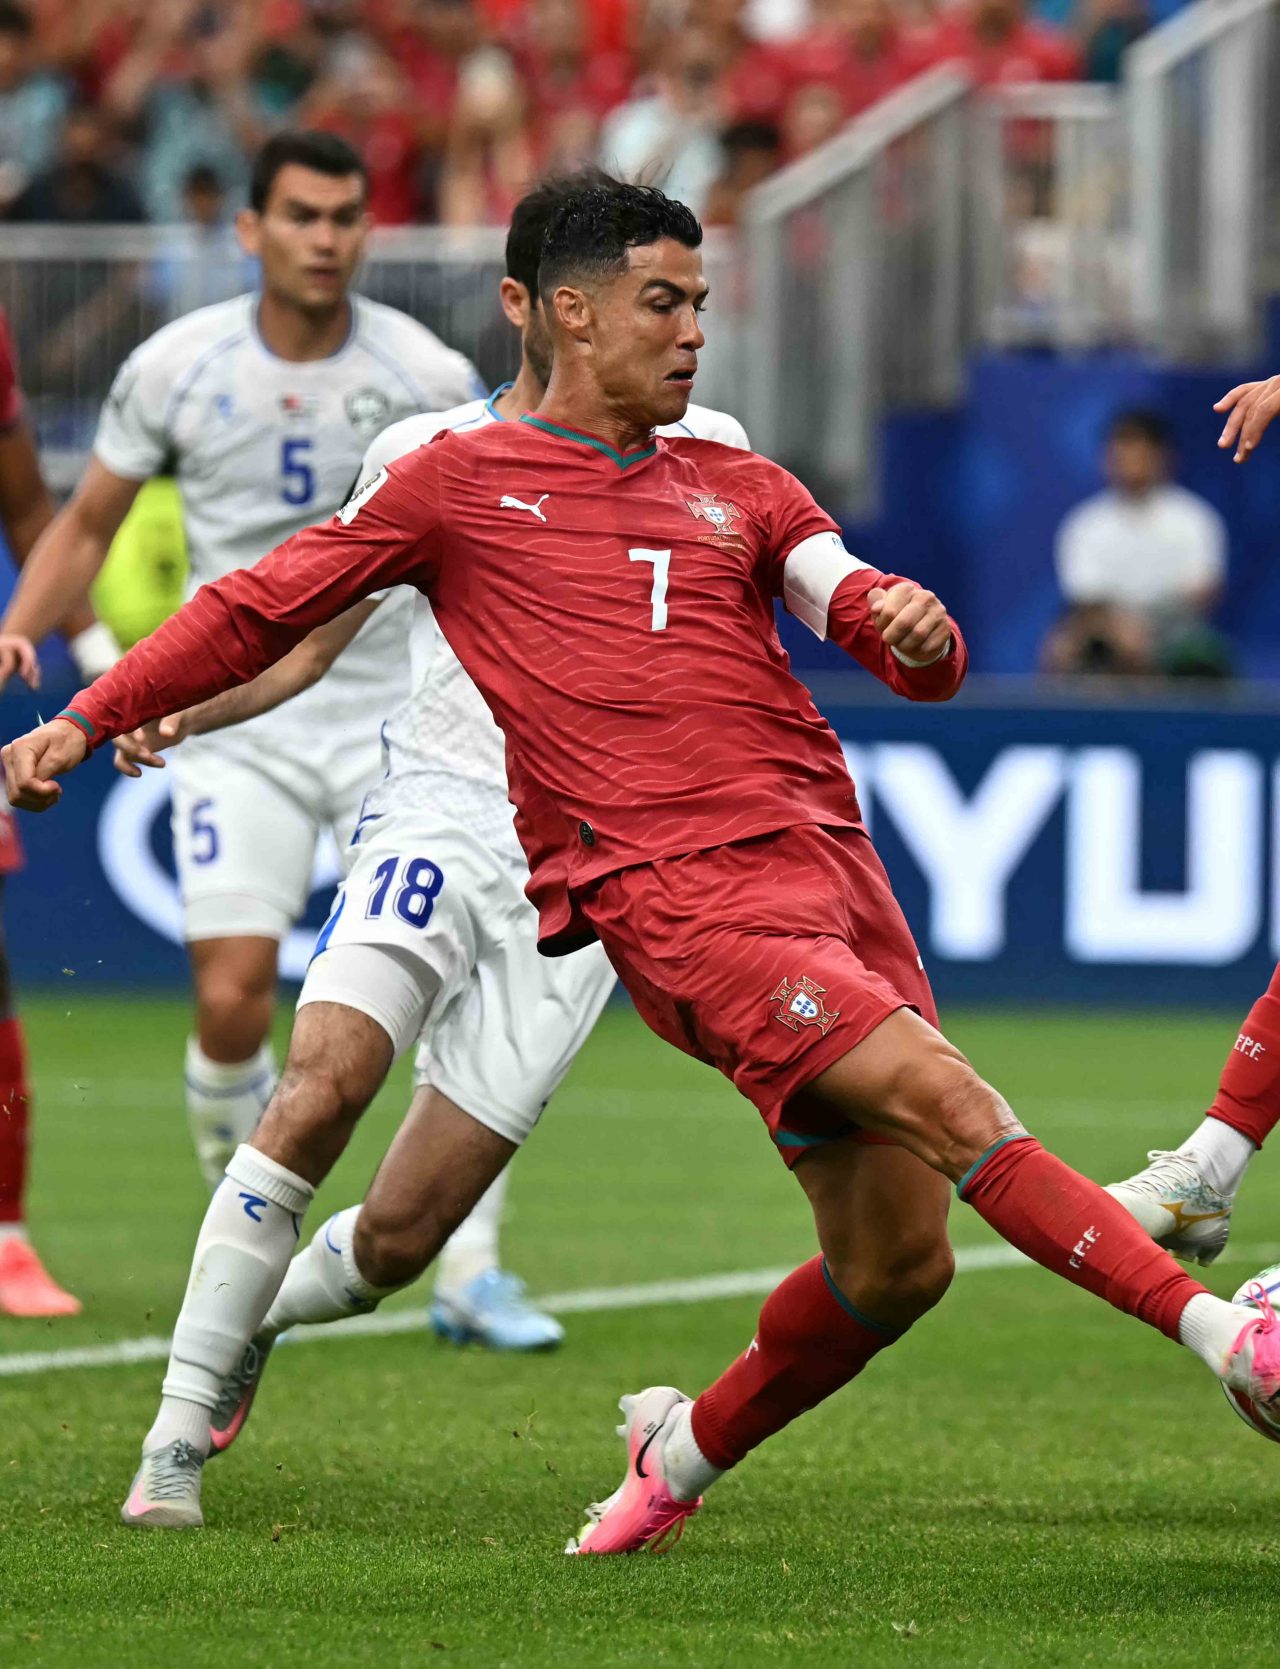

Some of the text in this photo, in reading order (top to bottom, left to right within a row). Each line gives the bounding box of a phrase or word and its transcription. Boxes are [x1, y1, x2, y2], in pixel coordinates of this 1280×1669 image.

[281, 437, 315, 506] 5
[627, 547, 672, 632] 7
[190, 797, 220, 865] 5
[364, 856, 444, 930] 18
